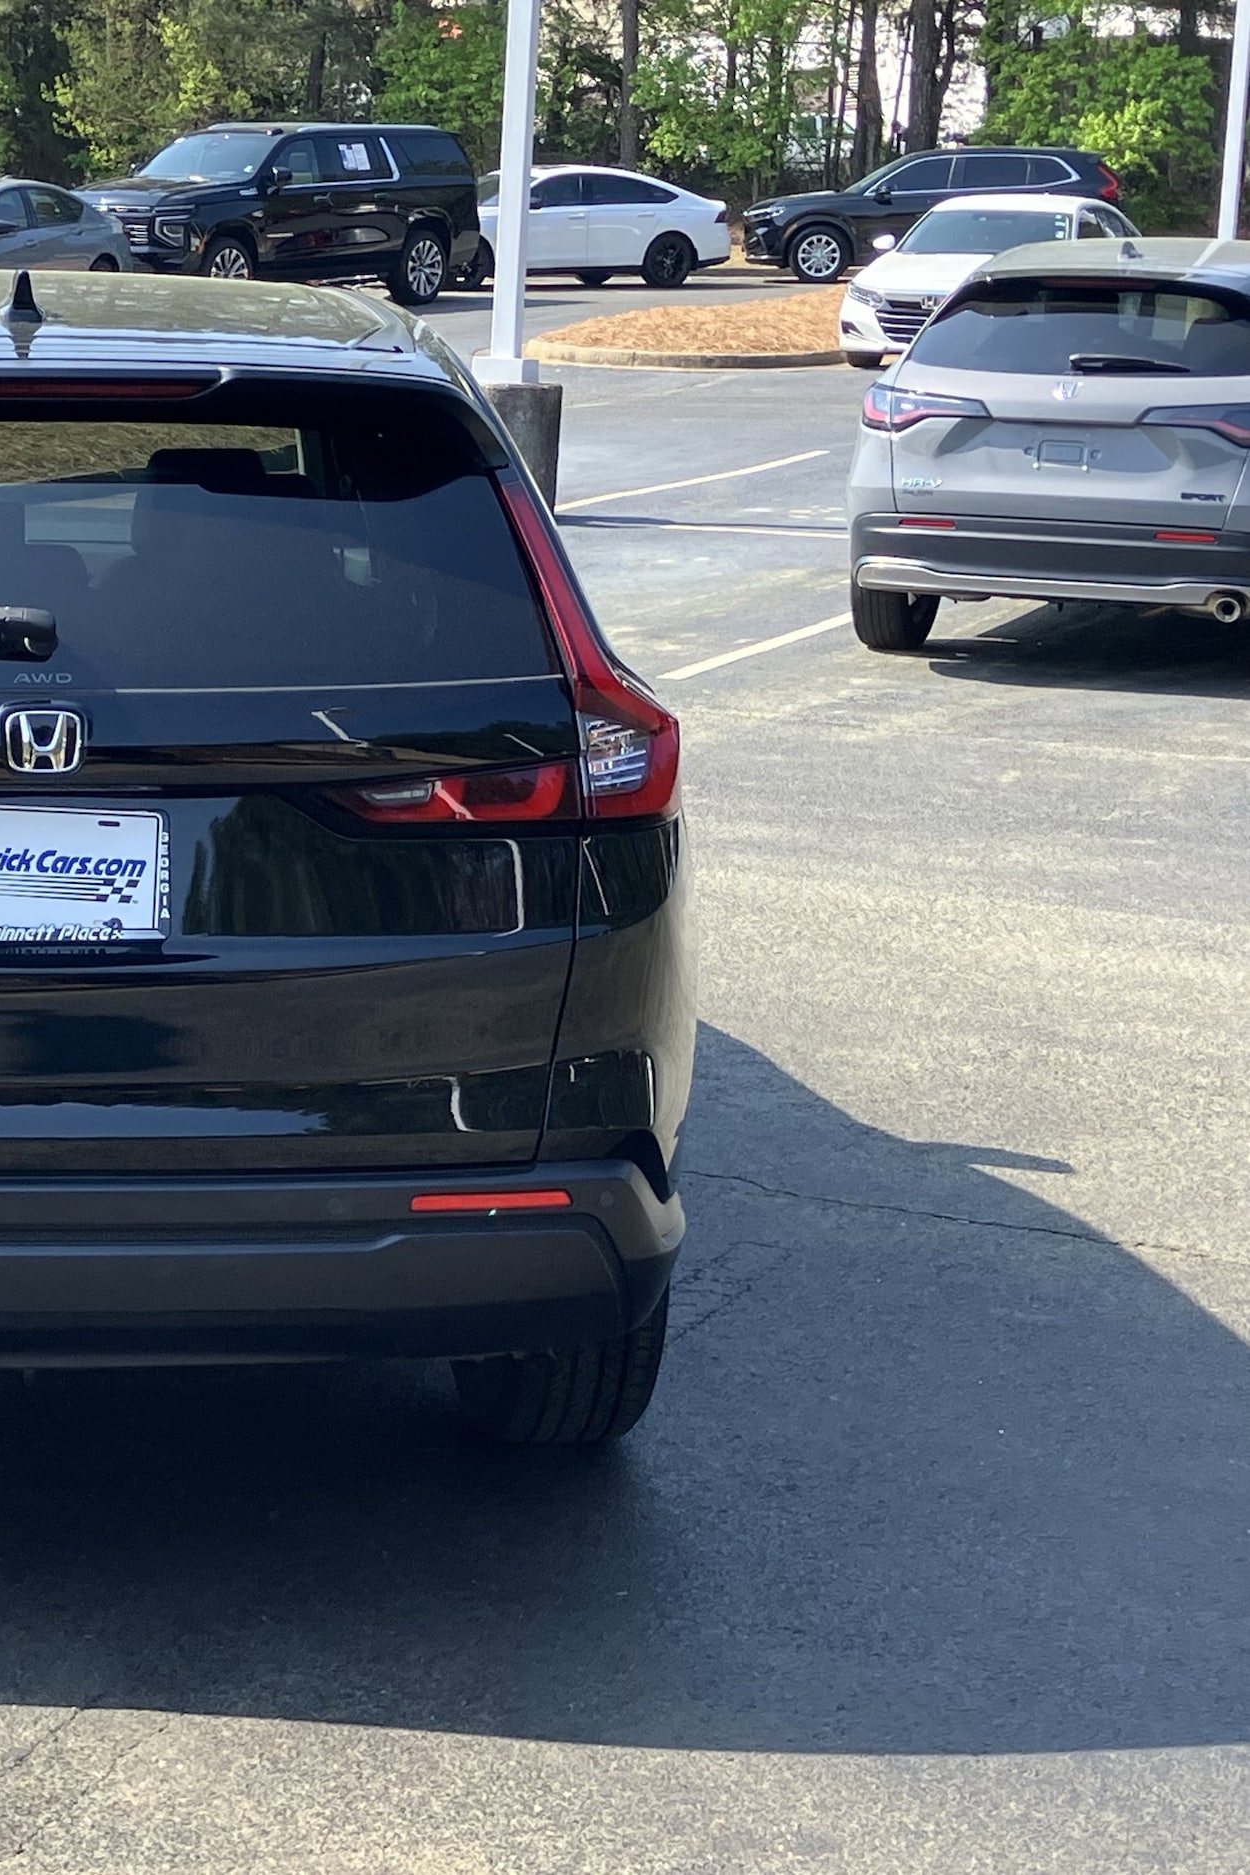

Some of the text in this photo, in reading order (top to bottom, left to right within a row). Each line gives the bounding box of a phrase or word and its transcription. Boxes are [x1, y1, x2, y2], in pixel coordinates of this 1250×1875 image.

[901, 477, 943, 488] HR-V
[13, 672, 72, 684] AWD
[160, 831, 170, 919] GEORGIA
[57, 924, 113, 942] Place
